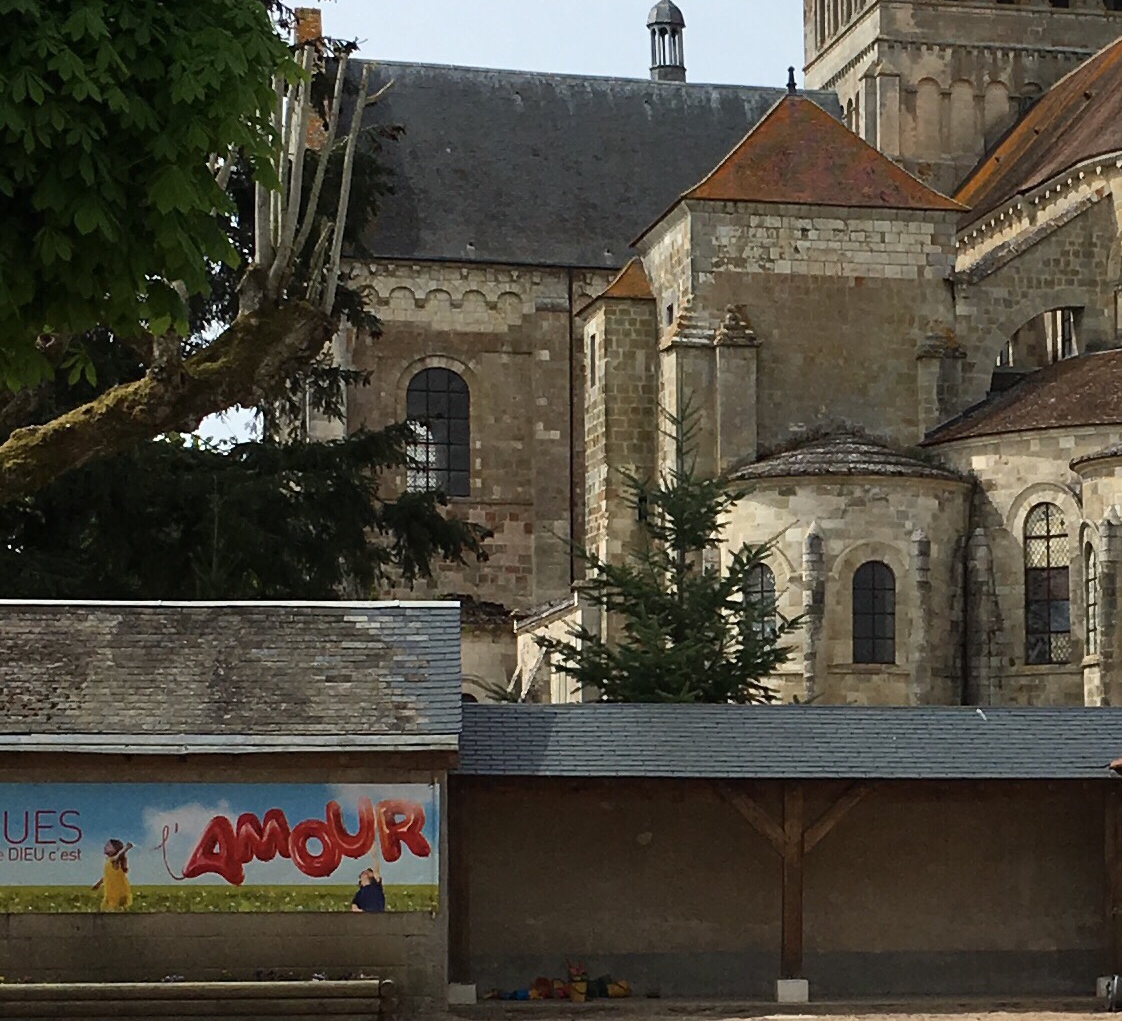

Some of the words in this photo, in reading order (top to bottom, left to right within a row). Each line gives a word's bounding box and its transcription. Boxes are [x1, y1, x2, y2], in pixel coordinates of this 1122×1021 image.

[3, 810, 82, 844] UES
[8, 847, 45, 861] DIEU
[48, 848, 82, 861] c'est
